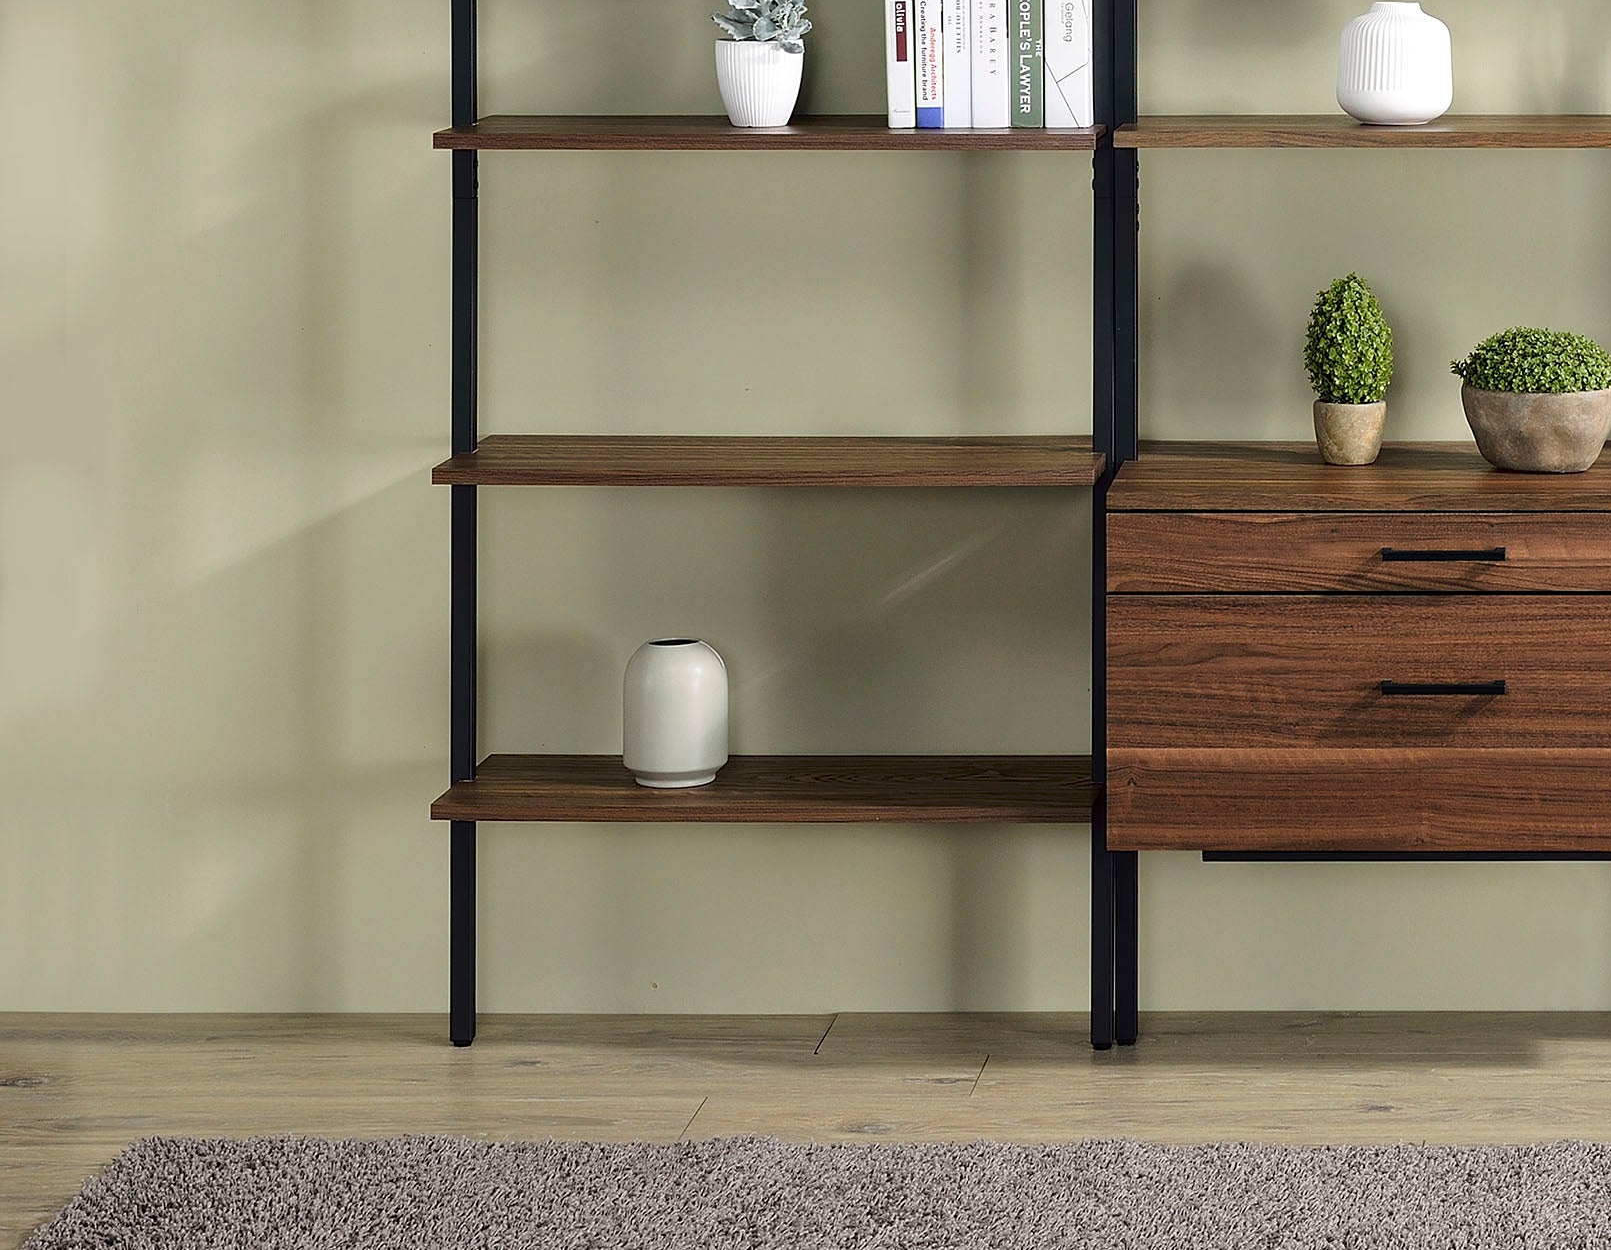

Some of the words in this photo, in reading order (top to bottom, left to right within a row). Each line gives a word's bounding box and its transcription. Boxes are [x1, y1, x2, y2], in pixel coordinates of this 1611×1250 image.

[895, 2, 905, 33] olivia
[918, 0, 928, 32] Creating
[1063, 2, 1075, 43] Gelang
[919, 33, 928, 46] the
[927, 27, 937, 63] Anderegg
[920, 47, 929, 78] furniture
[921, 79, 930, 101] brand
[928, 63, 938, 100] Architects
[1019, 53, 1033, 114] LAWYER
